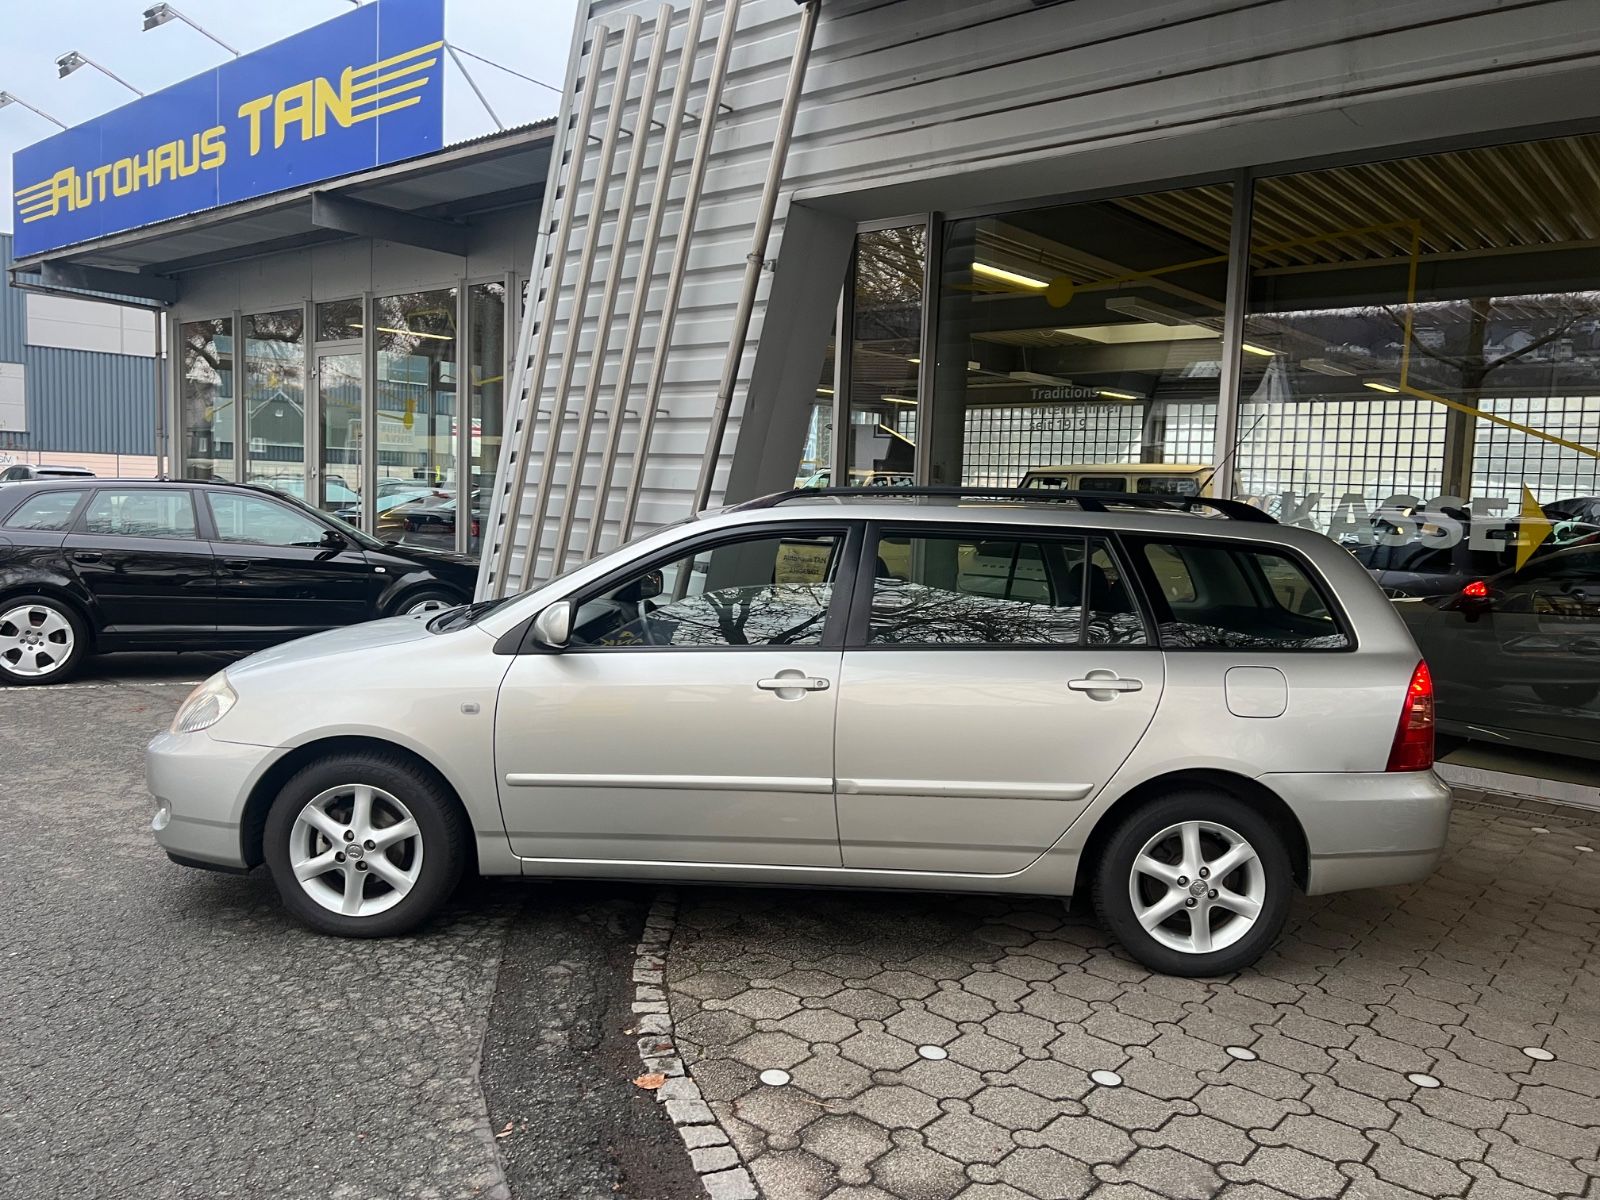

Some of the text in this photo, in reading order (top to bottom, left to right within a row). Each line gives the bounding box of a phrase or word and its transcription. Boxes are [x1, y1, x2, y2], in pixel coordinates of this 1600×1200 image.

[51, 66, 353, 217] AUTOHAUS TAN
[1030, 386, 1099, 400] Traditions
[1280, 491, 1509, 552] KASSE
